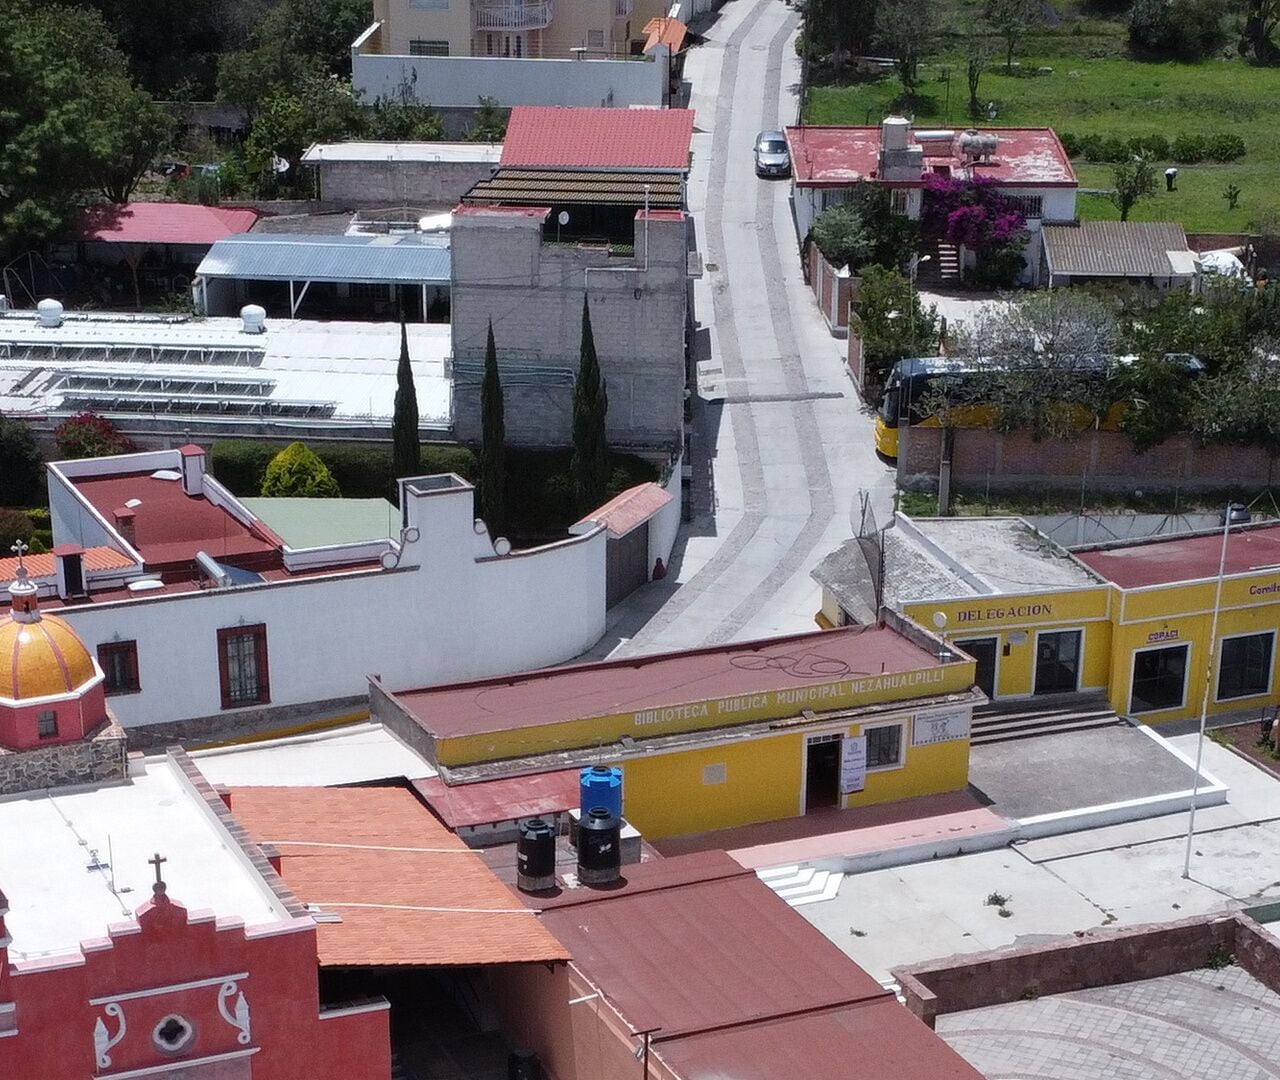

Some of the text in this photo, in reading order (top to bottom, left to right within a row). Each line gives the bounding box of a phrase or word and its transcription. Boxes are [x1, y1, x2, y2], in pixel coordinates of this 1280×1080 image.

[958, 604, 1052, 621] DELEGACION
[634, 669, 945, 725] BIBLIOTECA PUBLICA MUNICIPAL NEZAHUALPILLI
